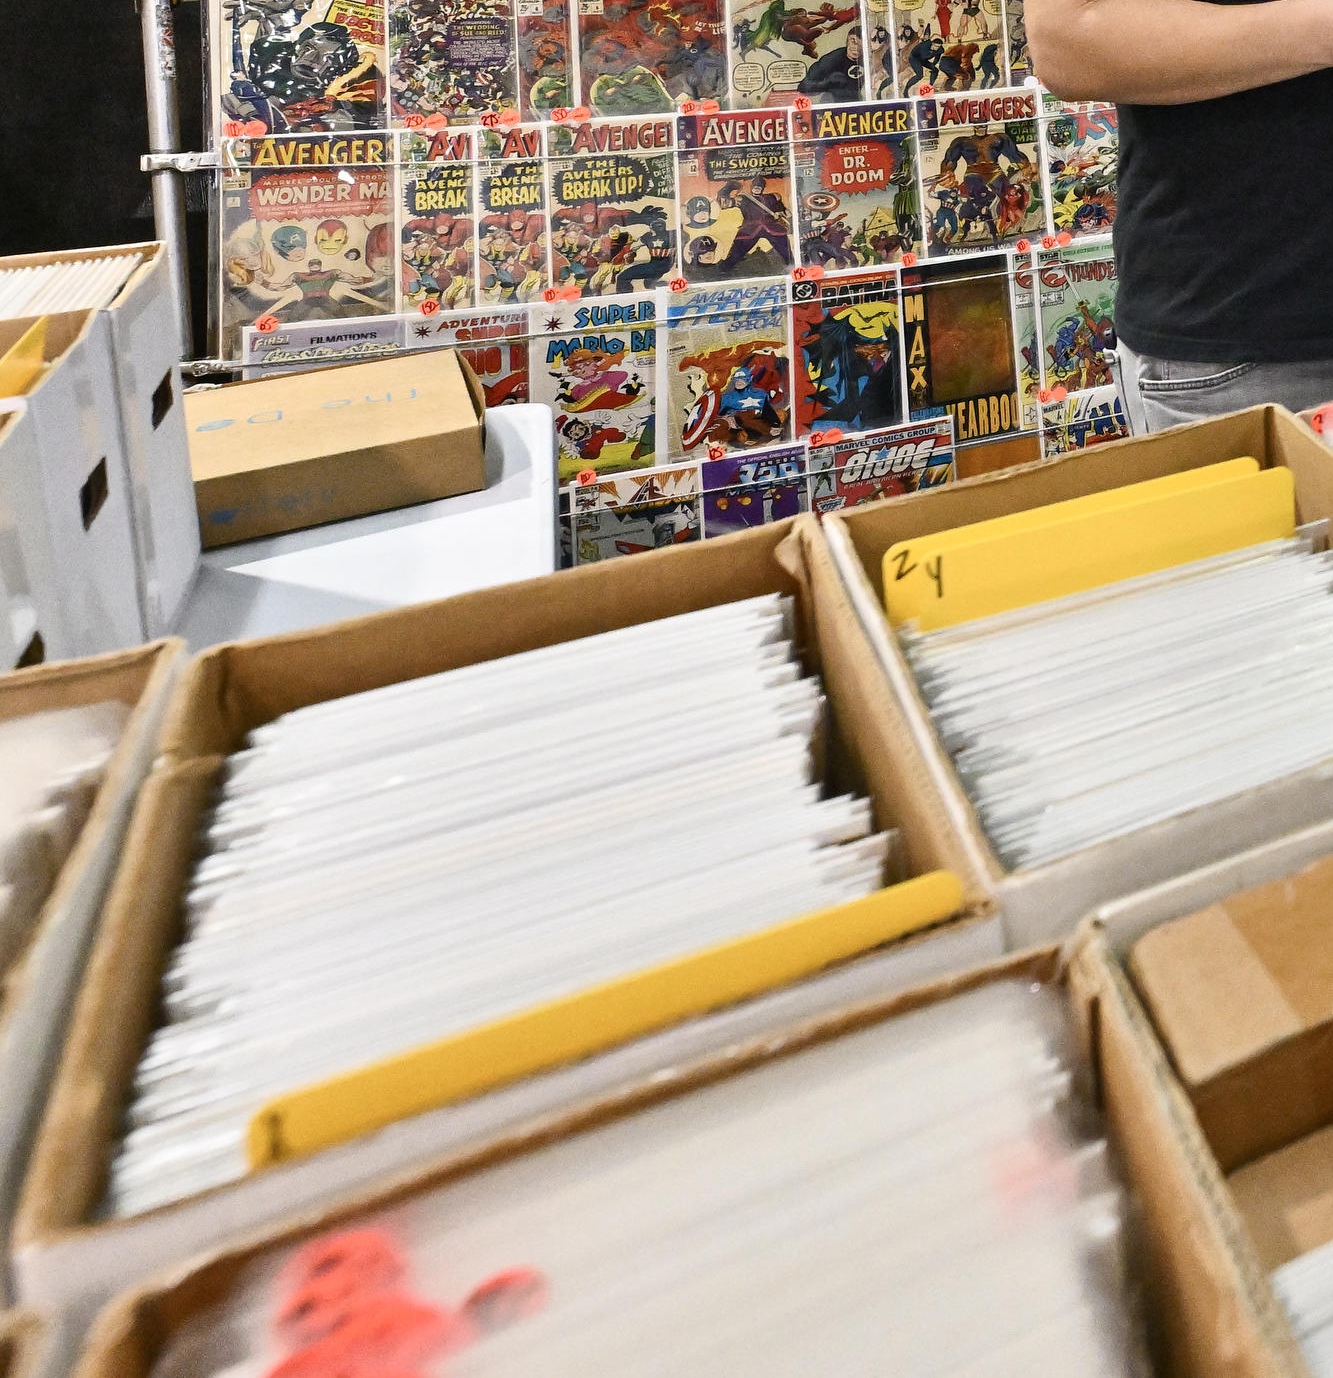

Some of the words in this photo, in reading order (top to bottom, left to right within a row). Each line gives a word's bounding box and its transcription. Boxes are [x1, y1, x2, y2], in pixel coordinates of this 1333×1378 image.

[940, 94, 1037, 125] AVENGERS
[586, 159, 617, 170] THE
[709, 159, 728, 169] THE
[843, 155, 871, 169] DR.
[562, 167, 633, 182] AVENGERS
[831, 169, 884, 186] DOOM
[257, 186, 341, 205] WONDER
[562, 180, 612, 201] BREAK
[614, 174, 644, 195] UP!
[310, 331, 377, 345] FILMATION'S
[548, 331, 627, 363] MARIO
[836, 440, 870, 452] MARVEL
[871, 433, 906, 446] COMICS
[907, 426, 936, 439] GROUP
